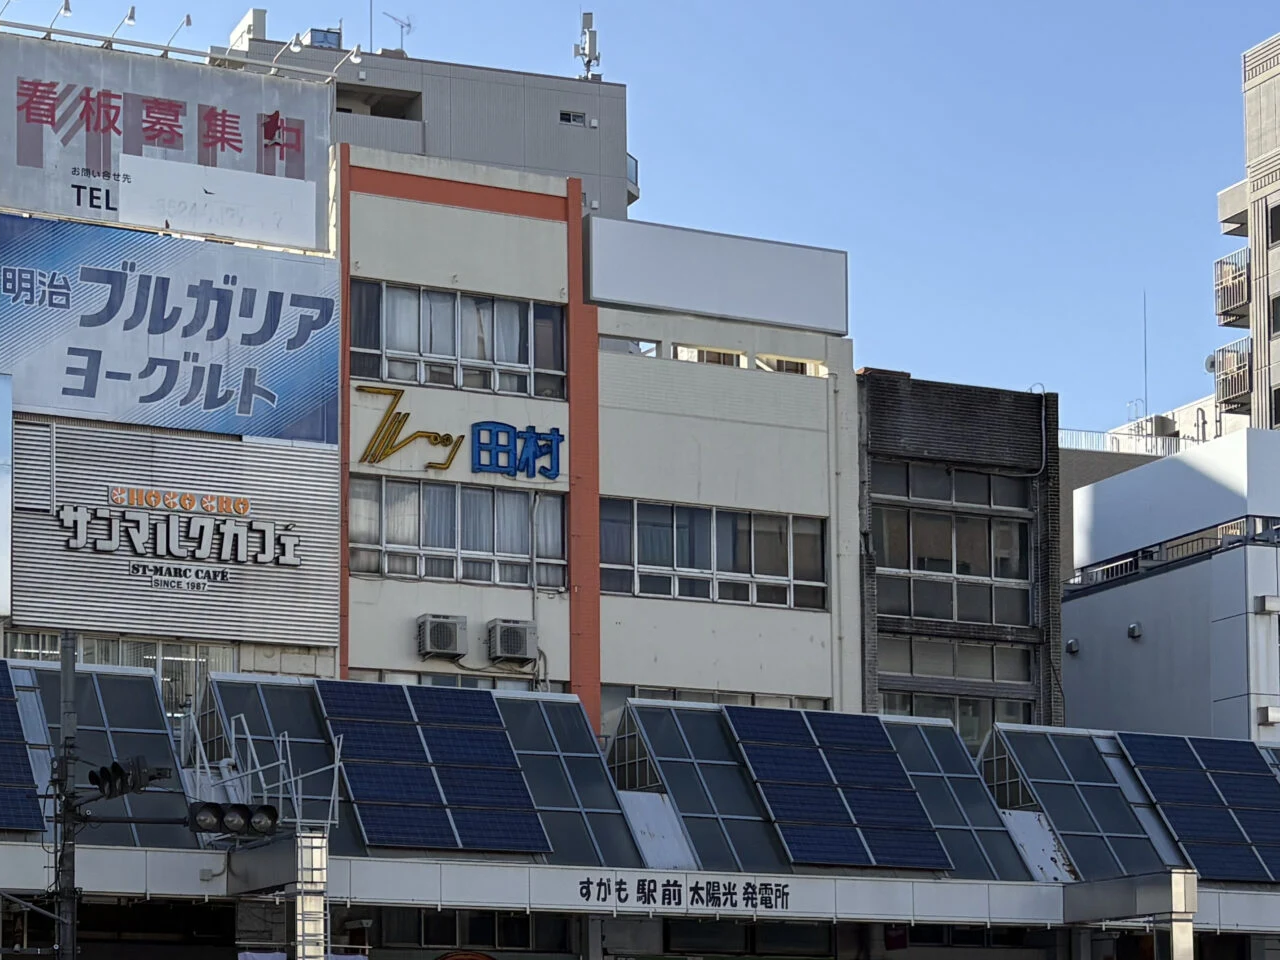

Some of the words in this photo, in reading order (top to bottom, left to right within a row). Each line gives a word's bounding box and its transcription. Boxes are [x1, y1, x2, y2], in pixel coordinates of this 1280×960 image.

[71, 184, 119, 212] TEL
[1, 265, 72, 311] 明治
[77, 259, 336, 352] ブルガリア
[60, 346, 280, 418] ヨーグルト
[470, 420, 565, 481] 田村
[110, 486, 197, 512] CHOCO
[200, 493, 251, 515] CRO
[152, 579, 183, 590] SINCE
[185, 581, 208, 591] 1987
